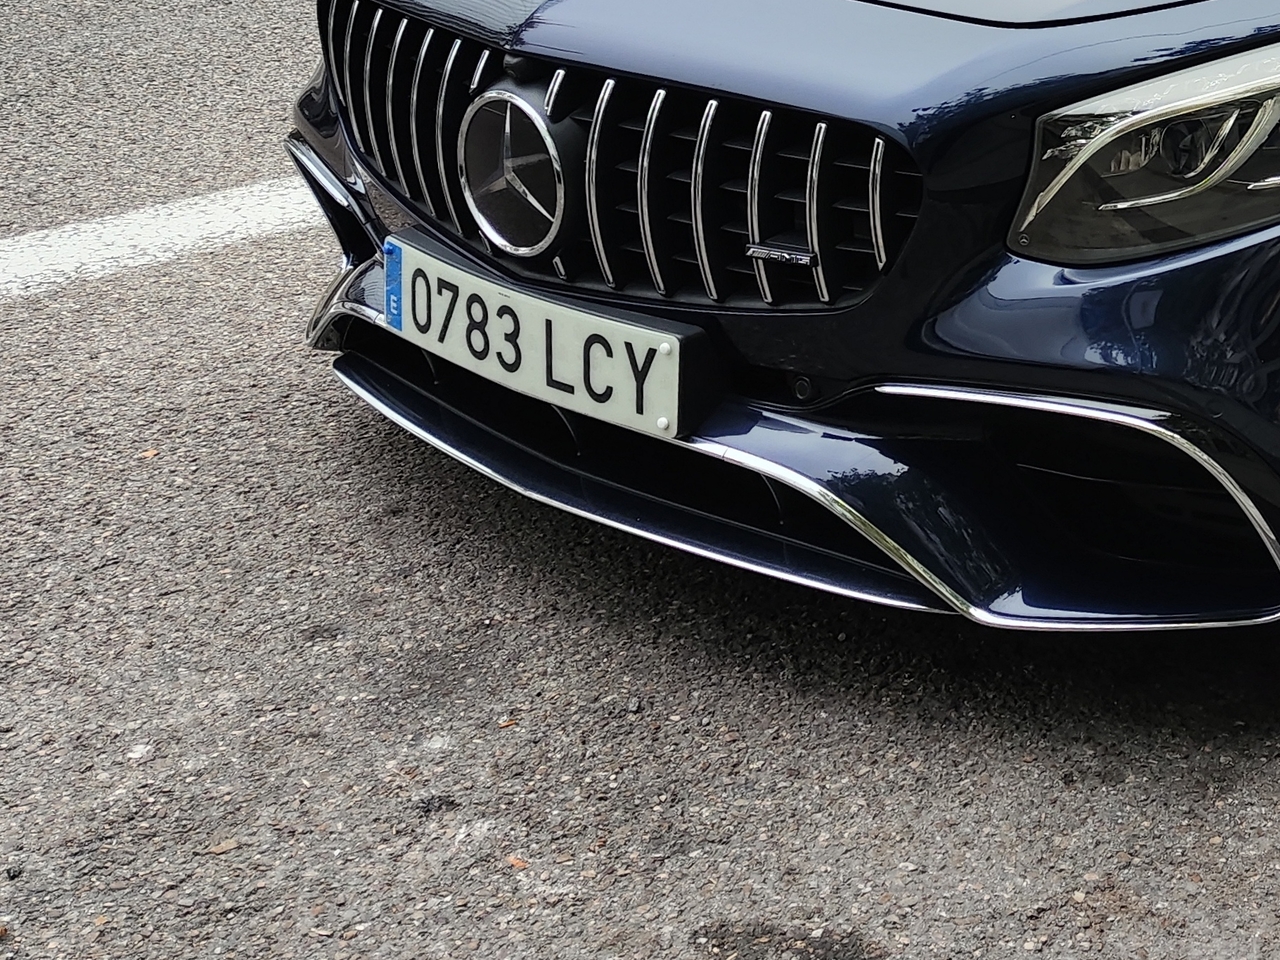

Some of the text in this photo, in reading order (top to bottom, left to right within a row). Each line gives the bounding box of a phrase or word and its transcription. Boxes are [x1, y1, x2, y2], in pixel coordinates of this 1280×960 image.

[390, 293, 398, 315] E
[411, 268, 658, 416] 0783 LCY
